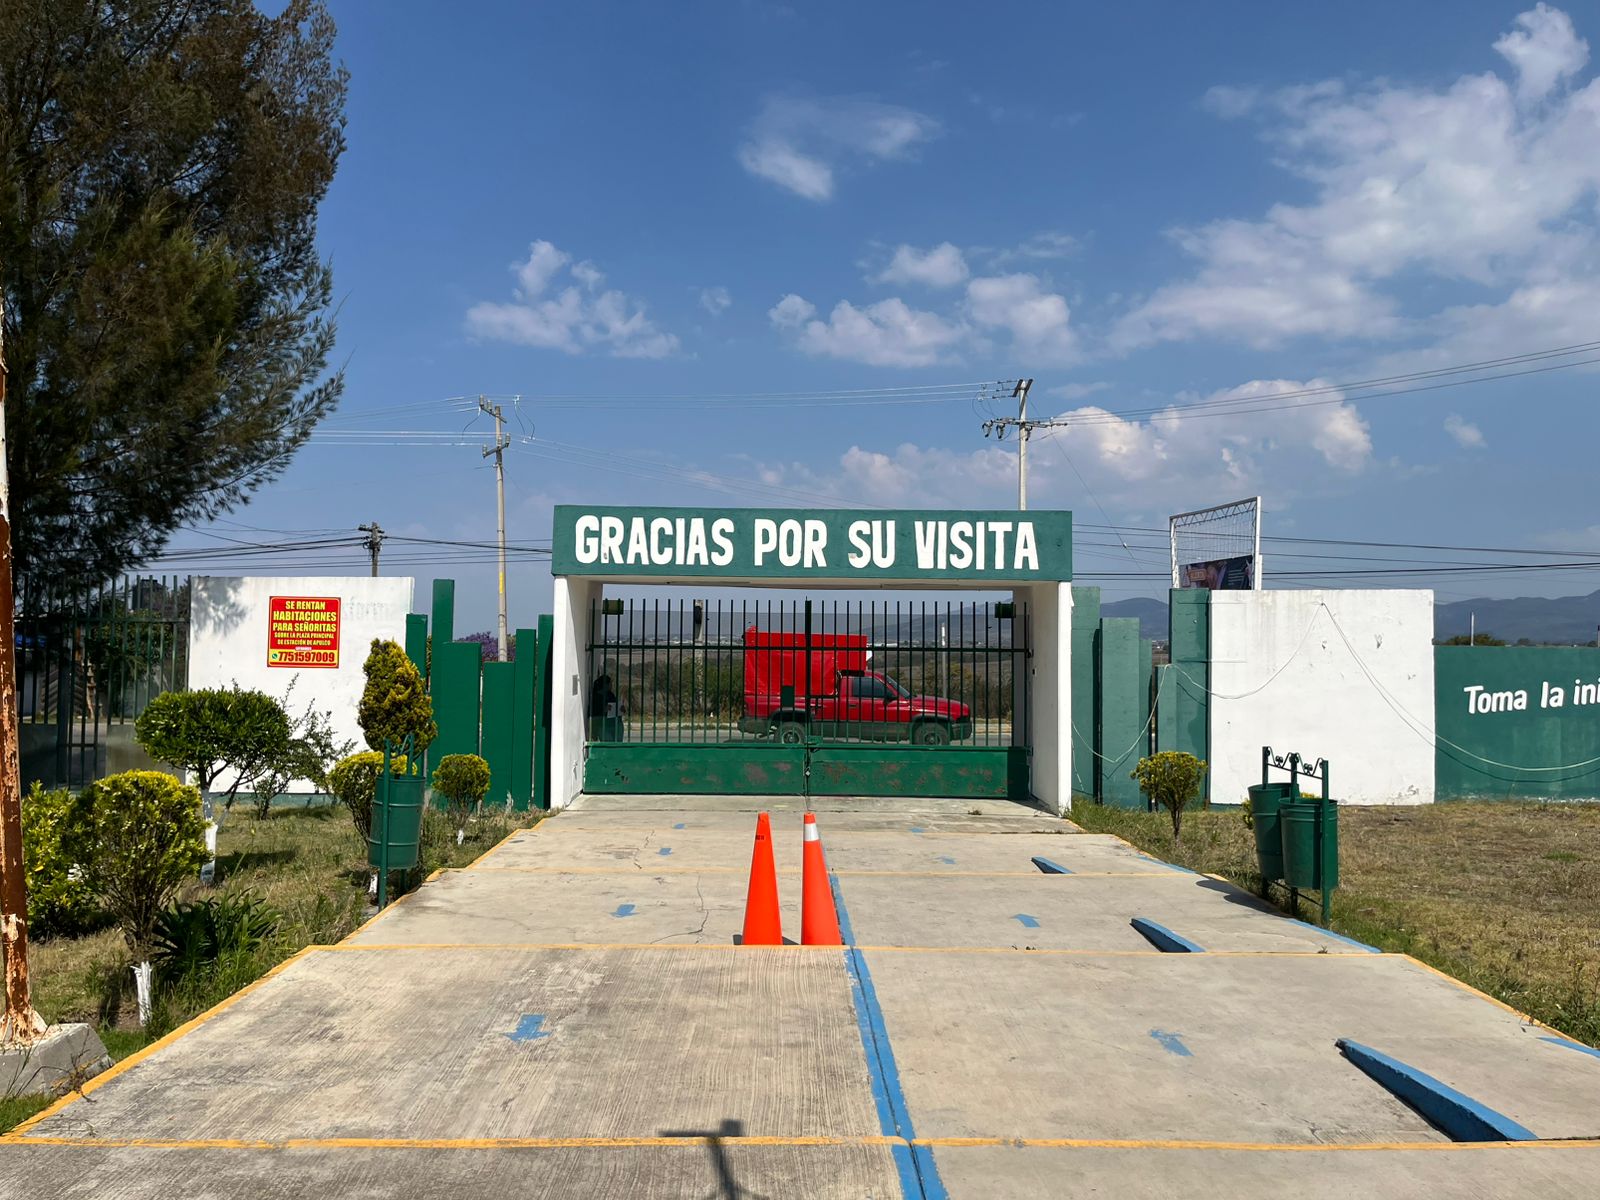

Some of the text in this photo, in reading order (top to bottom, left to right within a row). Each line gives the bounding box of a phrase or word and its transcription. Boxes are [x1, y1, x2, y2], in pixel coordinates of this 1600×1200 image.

[575, 514, 1039, 570] GRACIAS POR SU VISITA
[285, 601, 326, 610] SE RENTAN
[273, 611, 337, 622] HABITACIONES
[272, 621, 337, 632] PARA SEÑORITAS
[278, 651, 335, 662] 7751597009
[1463, 685, 1528, 714] Toma
[1540, 681, 1564, 708] la
